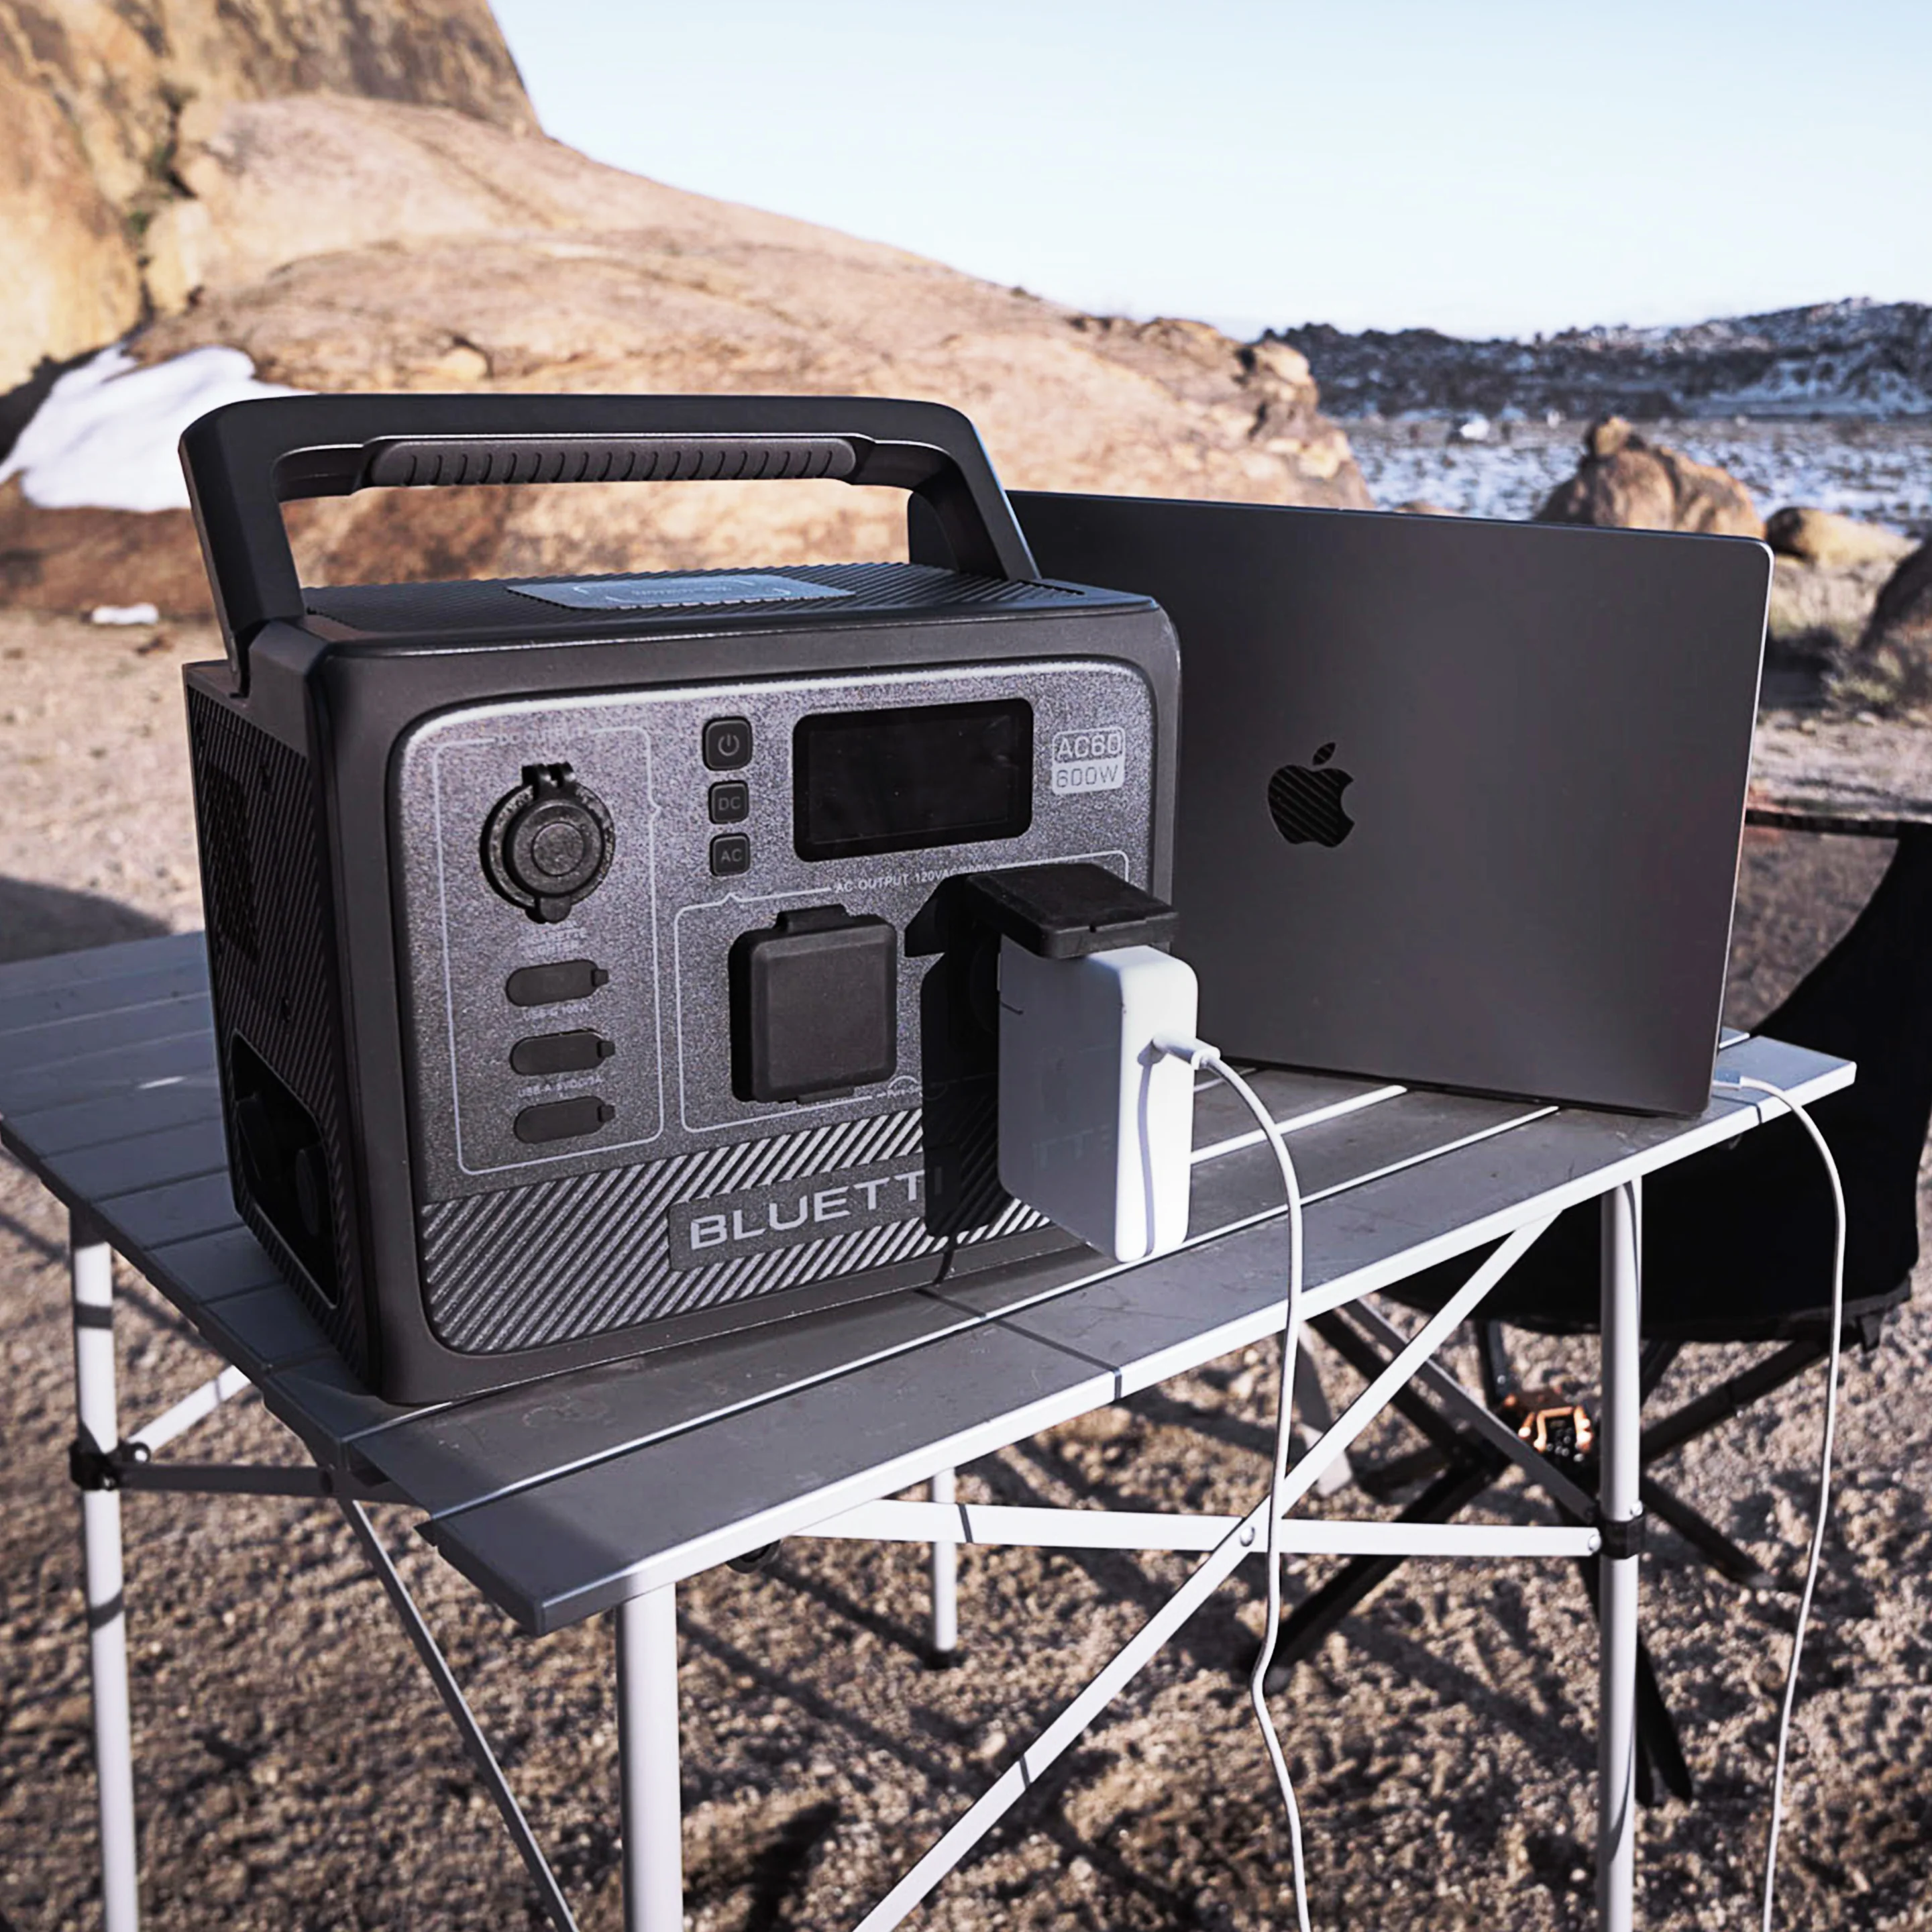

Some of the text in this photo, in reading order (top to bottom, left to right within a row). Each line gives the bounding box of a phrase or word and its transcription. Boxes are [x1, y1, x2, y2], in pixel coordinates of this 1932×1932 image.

[1057, 733, 1122, 761] AC60
[1057, 765, 1118, 788] 600W
[718, 796, 741, 811] DC
[720, 849, 742, 863] AC
[835, 881, 853, 894] AC
[858, 873, 909, 890] OUTPUT
